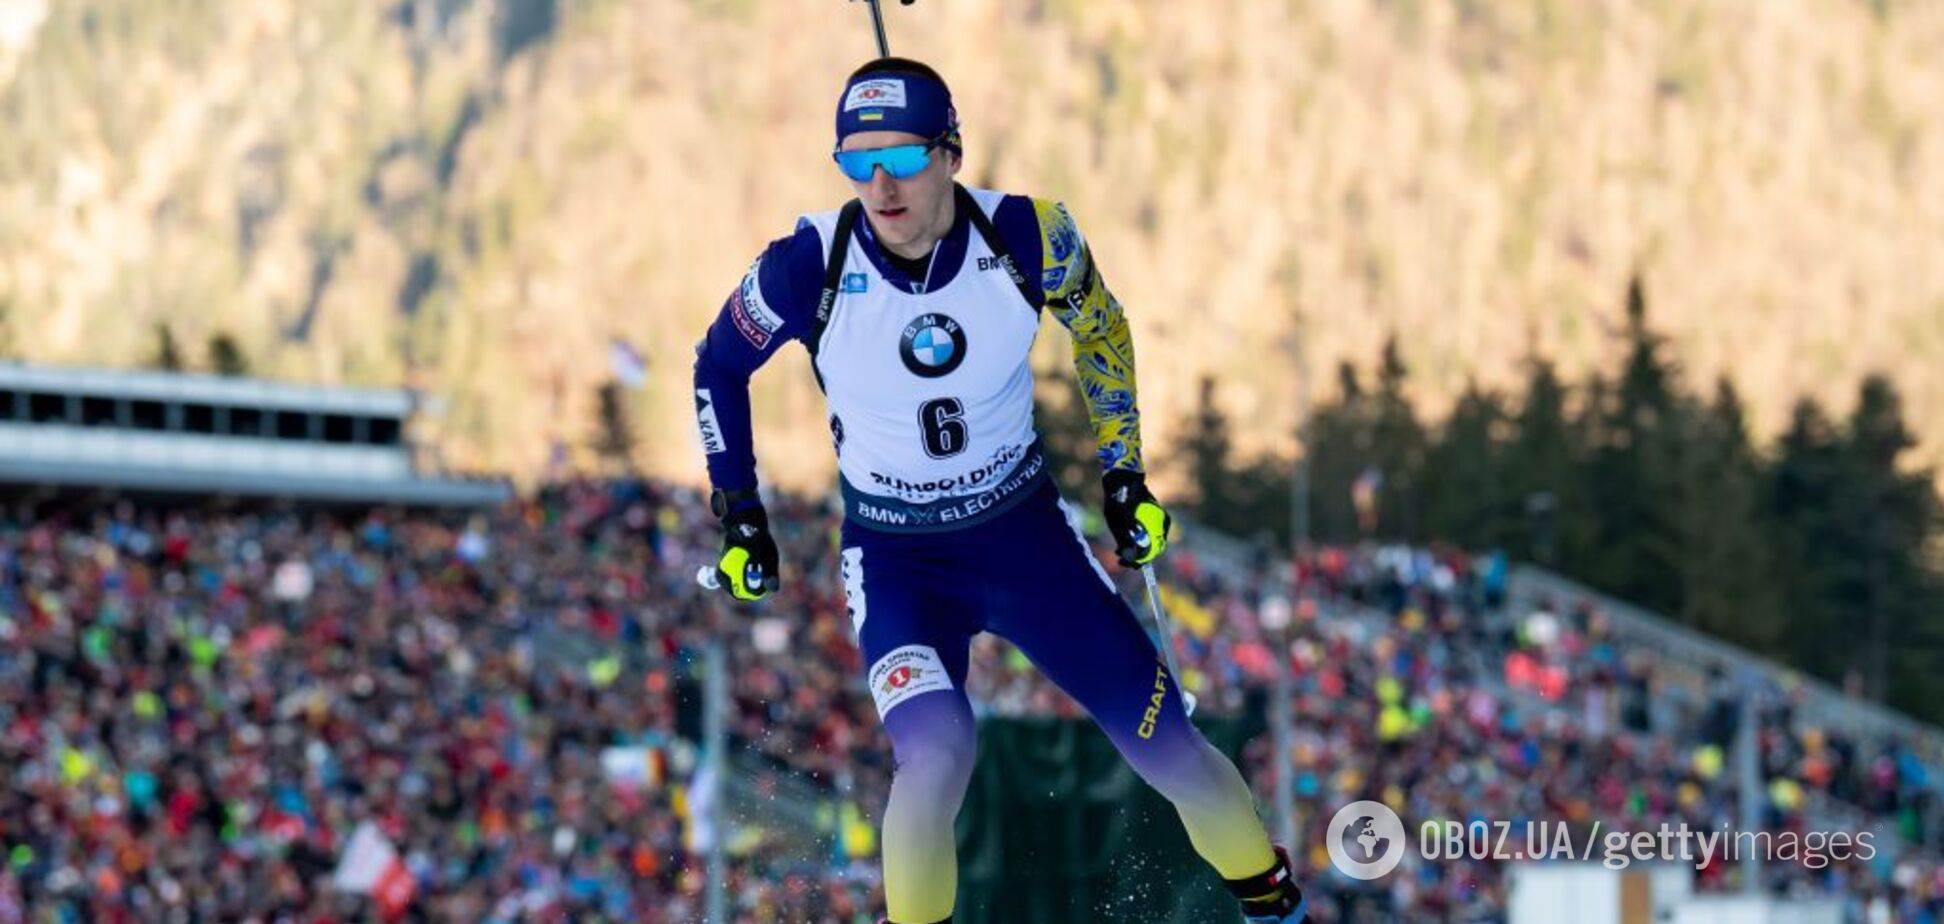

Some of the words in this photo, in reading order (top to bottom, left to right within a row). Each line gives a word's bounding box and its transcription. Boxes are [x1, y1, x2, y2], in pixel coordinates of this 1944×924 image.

[904, 315, 958, 339] BMW
[918, 396, 969, 460] 6
[858, 500, 908, 525] BMW
[1137, 669, 1168, 739] CRAFT
